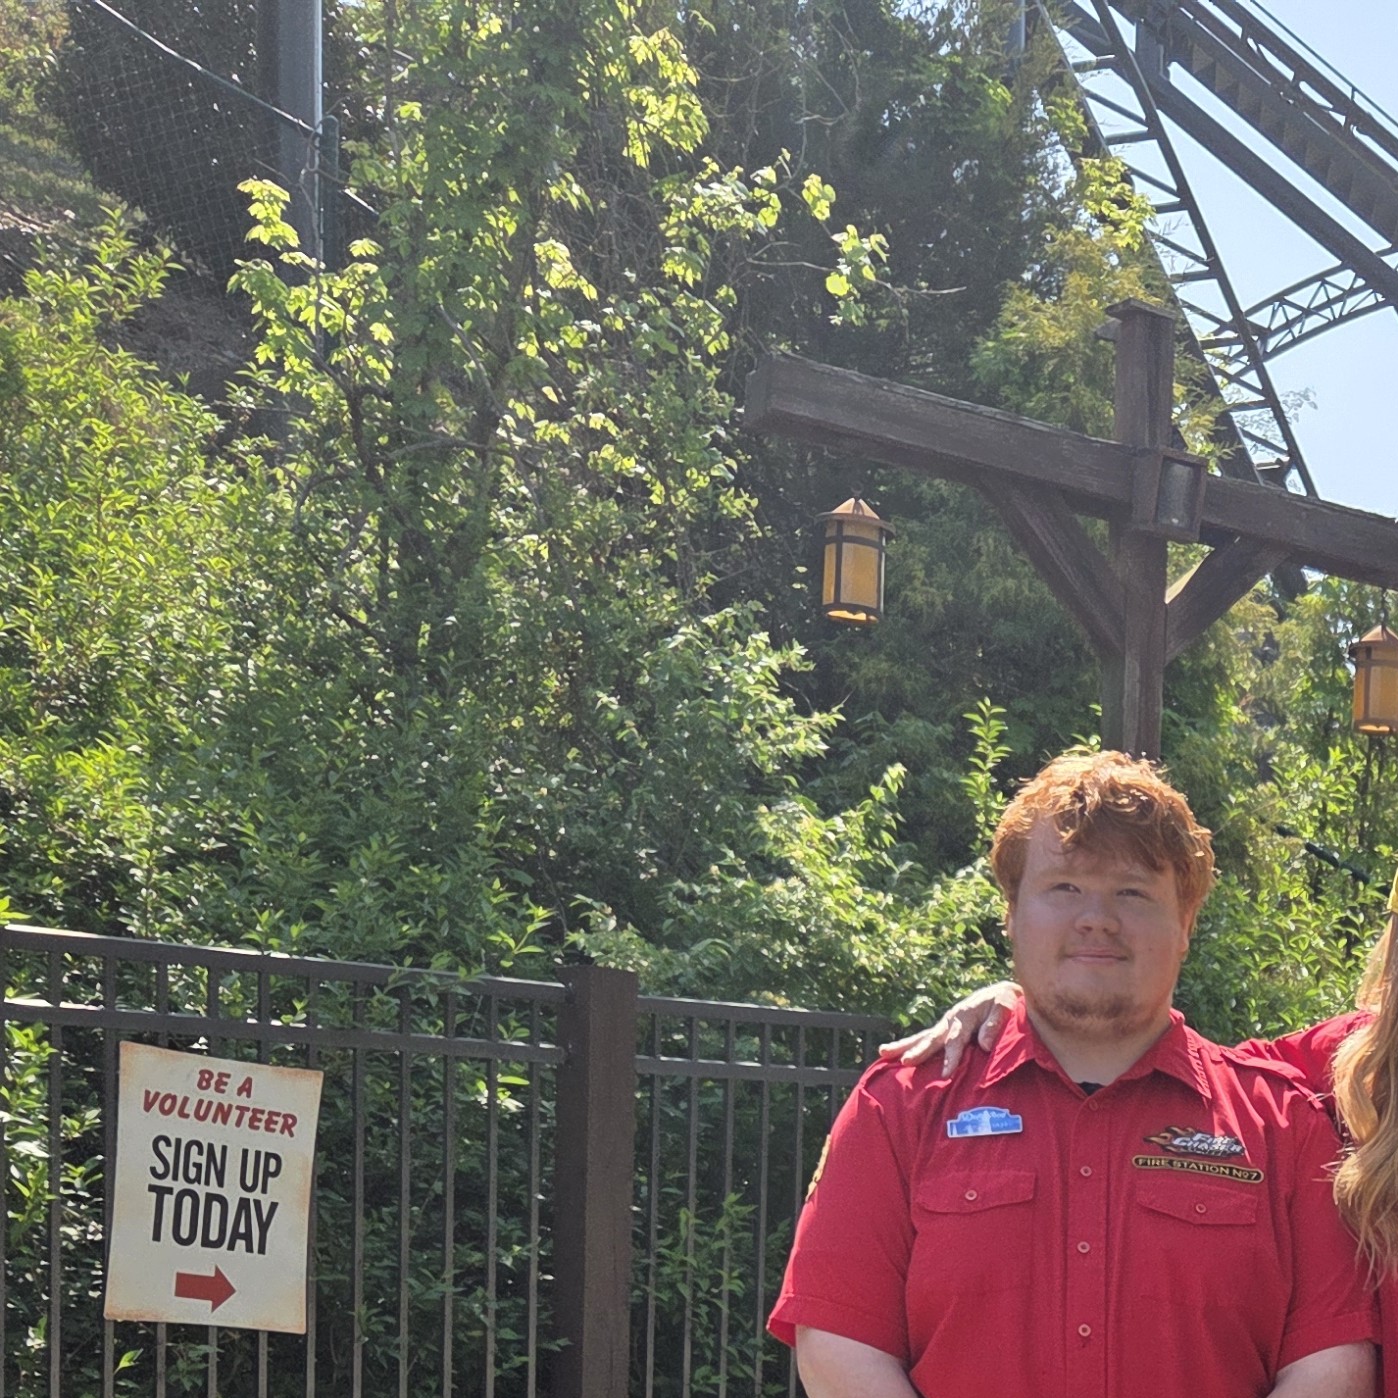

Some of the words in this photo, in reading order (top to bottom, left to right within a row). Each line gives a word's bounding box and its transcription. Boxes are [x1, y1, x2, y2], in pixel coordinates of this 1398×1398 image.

[196, 1069, 231, 1094] BE
[237, 1076, 253, 1098] A
[142, 1089, 298, 1138] VOLUNTEER
[149, 1135, 228, 1188] SIGN
[239, 1147, 282, 1194] UP
[1138, 1158, 1169, 1167] FIRE
[1172, 1161, 1230, 1175] STATION
[147, 1184, 280, 1255] TODAY
